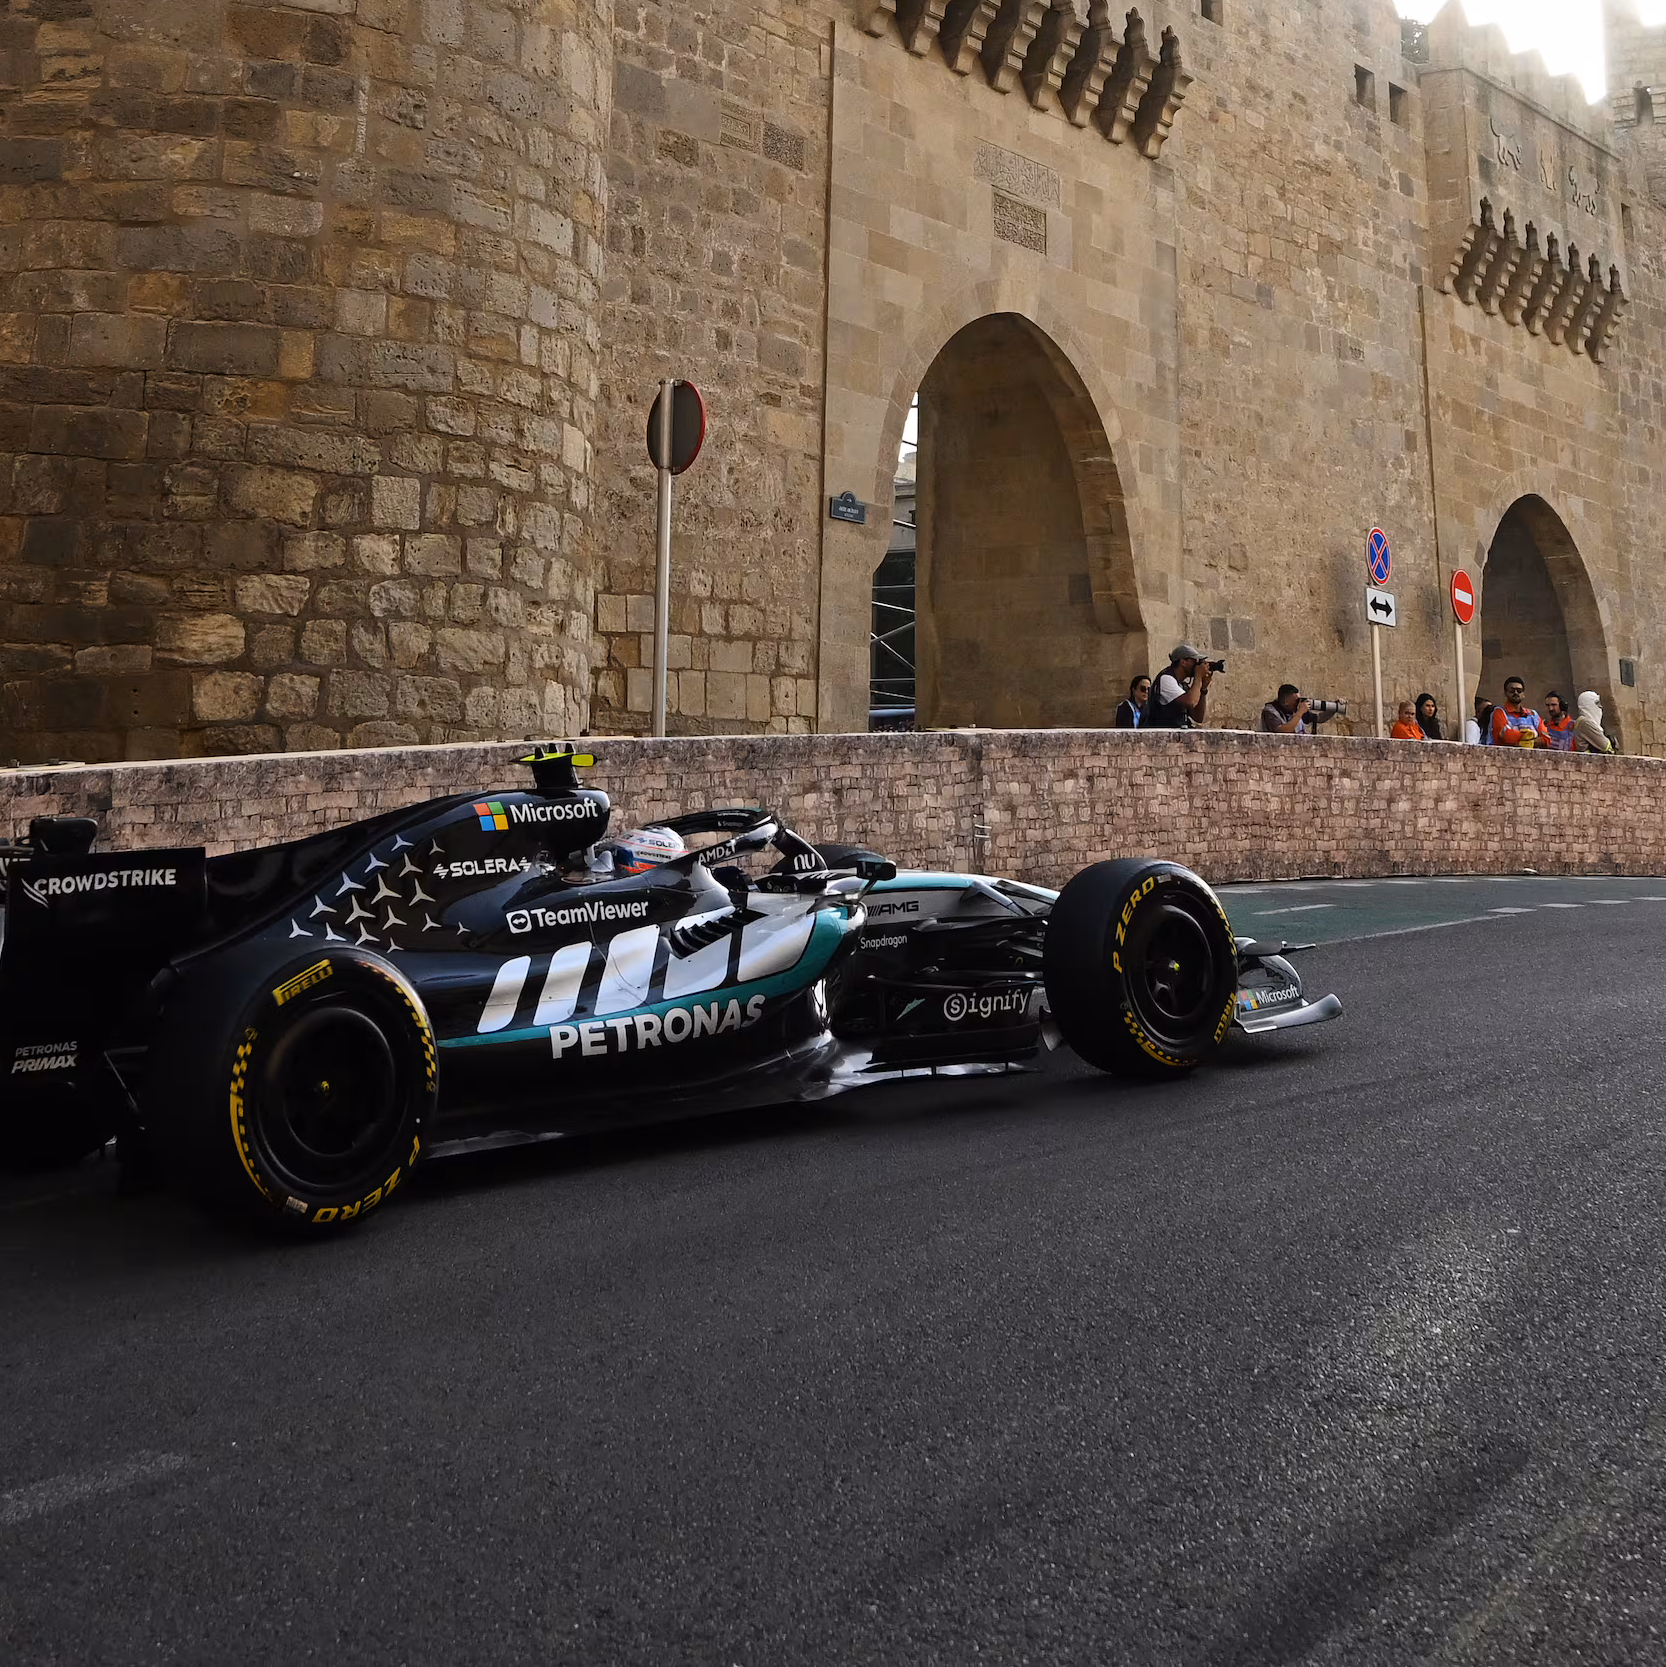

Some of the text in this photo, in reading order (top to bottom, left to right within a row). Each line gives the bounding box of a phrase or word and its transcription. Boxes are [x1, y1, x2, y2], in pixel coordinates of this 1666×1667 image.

[510, 797, 598, 823] Microsoft
[698, 846, 725, 866] AMD
[450, 858, 521, 878] SOLERA
[33, 868, 177, 896] CROWDSTRIKE
[531, 901, 649, 928] TeamViewer
[878, 900, 919, 917] AMG
[1115, 876, 1155, 947] ZERO
[860, 934, 908, 951] Snapdragon
[272, 958, 333, 1006] PIRELLI
[1255, 984, 1300, 1005] Microsoft
[548, 994, 766, 1060] PETRONAS
[15, 1041, 78, 1058] PETRONAS
[11, 1054, 79, 1074] PRIMAX
[310, 1167, 402, 1223] ZERO
